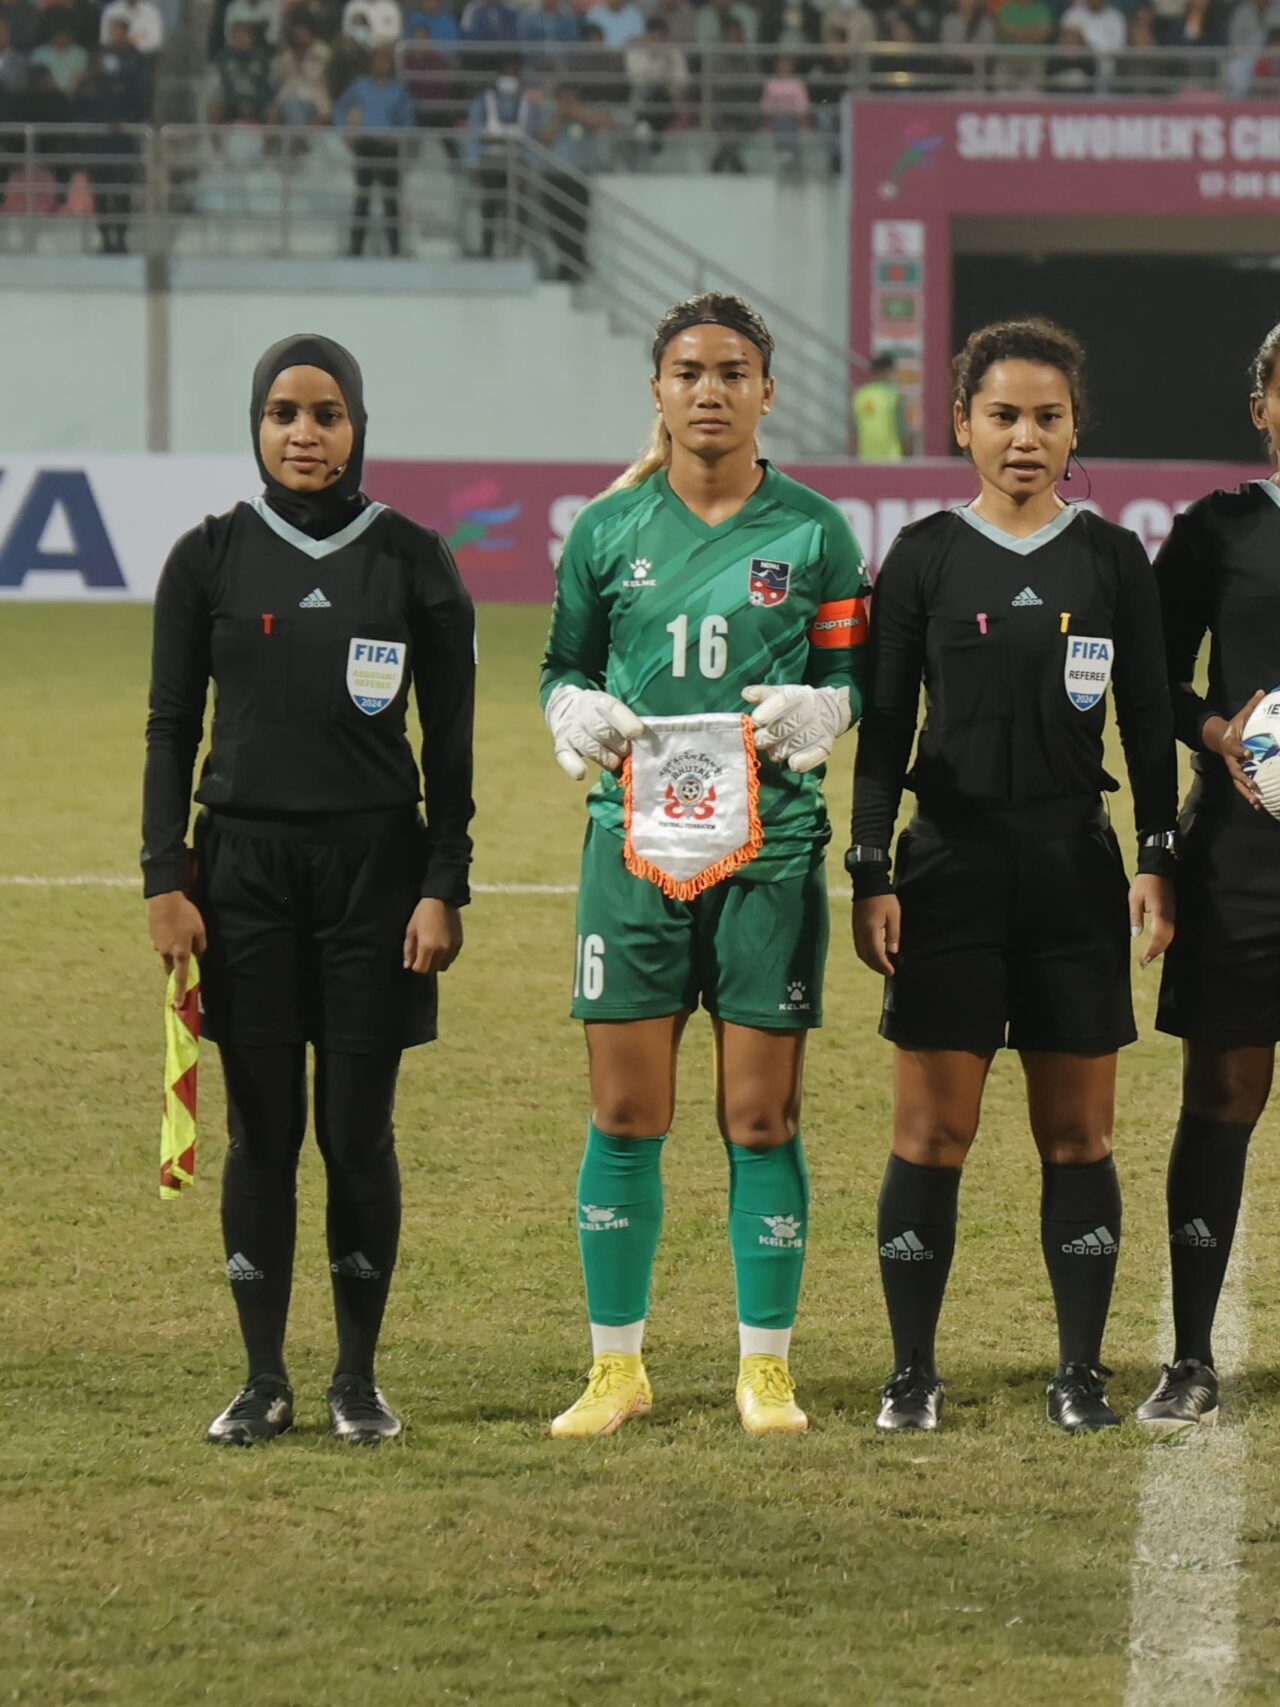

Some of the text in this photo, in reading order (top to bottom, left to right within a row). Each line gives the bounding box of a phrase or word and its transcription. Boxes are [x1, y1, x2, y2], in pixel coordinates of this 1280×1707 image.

[957, 113, 1044, 160] SAFF
[1050, 115, 1225, 161] WOMEN'S
[622, 580, 657, 588] KELME
[815, 617, 859, 631] CAPTAIN
[666, 614, 729, 679] 16
[1071, 641, 1109, 661] FIFA
[355, 643, 399, 665] FIFA
[1069, 670, 1106, 682] REFEREE
[361, 697, 383, 708] 2024
[1076, 694, 1094, 704] 2024
[880, 1246, 934, 1261] adidas
[1062, 1243, 1118, 1256] adidas
